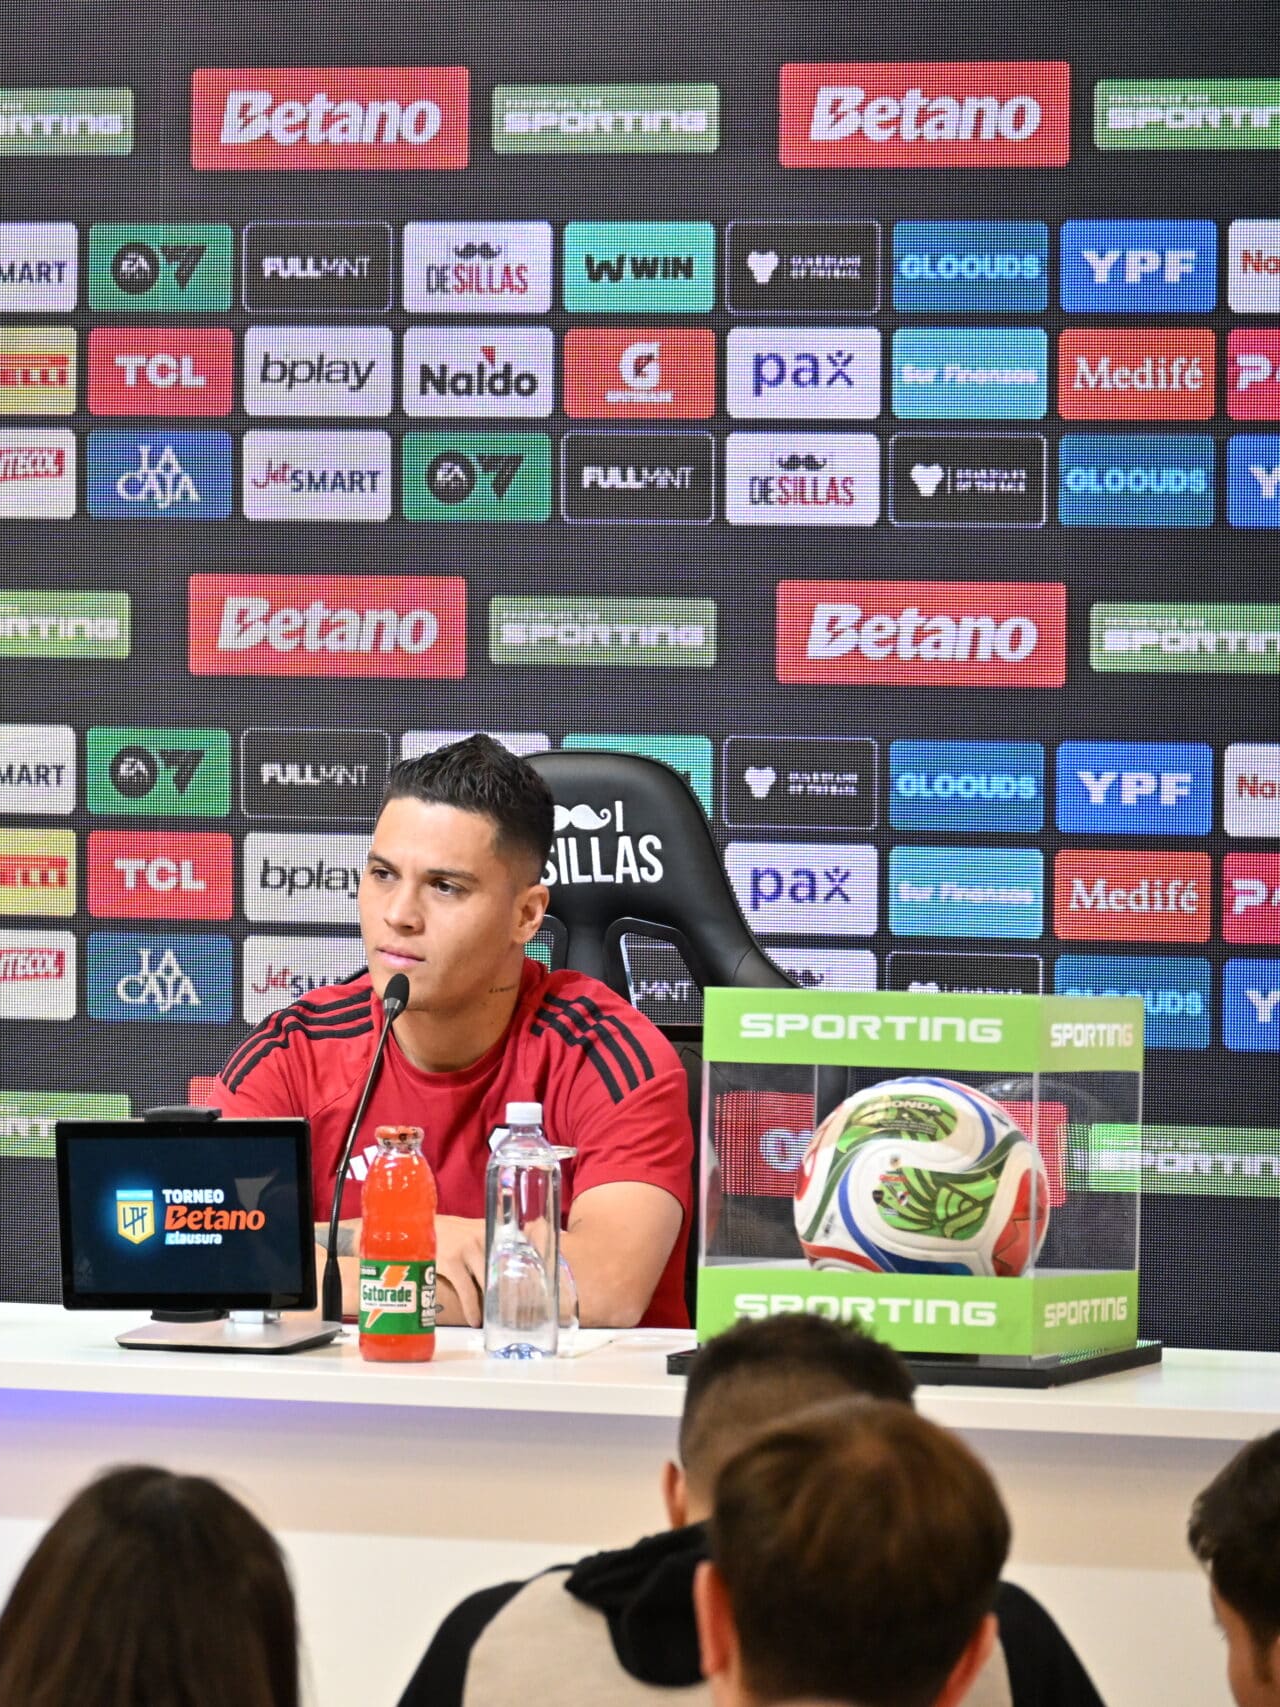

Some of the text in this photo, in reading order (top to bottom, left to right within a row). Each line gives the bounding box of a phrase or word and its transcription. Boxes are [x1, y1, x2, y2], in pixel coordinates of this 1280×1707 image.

[220, 91, 441, 145] Betano
[503, 108, 707, 133] SPORTING
[810, 86, 1041, 142] Betano
[1108, 104, 1280, 130] SPORTIN
[1083, 250, 1195, 283] YPF
[115, 353, 206, 388] TCL
[260, 353, 375, 392] bplay
[419, 363, 538, 397] Naldo
[753, 351, 853, 396] pax
[1073, 356, 1202, 390] Medifé
[217, 596, 438, 653] Betano
[501, 622, 704, 647] SPORTING
[807, 603, 1037, 661] Betano
[1104, 628, 1280, 654] SPORTIN
[1078, 771, 1191, 805] YPF
[115, 857, 206, 891] TCL
[751, 867, 850, 911] pax
[1069, 878, 1198, 913] Medifé
[740, 1013, 1002, 1043] SPORTING
[1051, 1023, 1133, 1047] SPORTING
[162, 1189, 224, 1204] TORNEO
[165, 1205, 266, 1231] Betano
[167, 1231, 222, 1245] clausura
[362, 1284, 412, 1302] Gatorade
[1044, 1297, 1128, 1327] SPORTING
